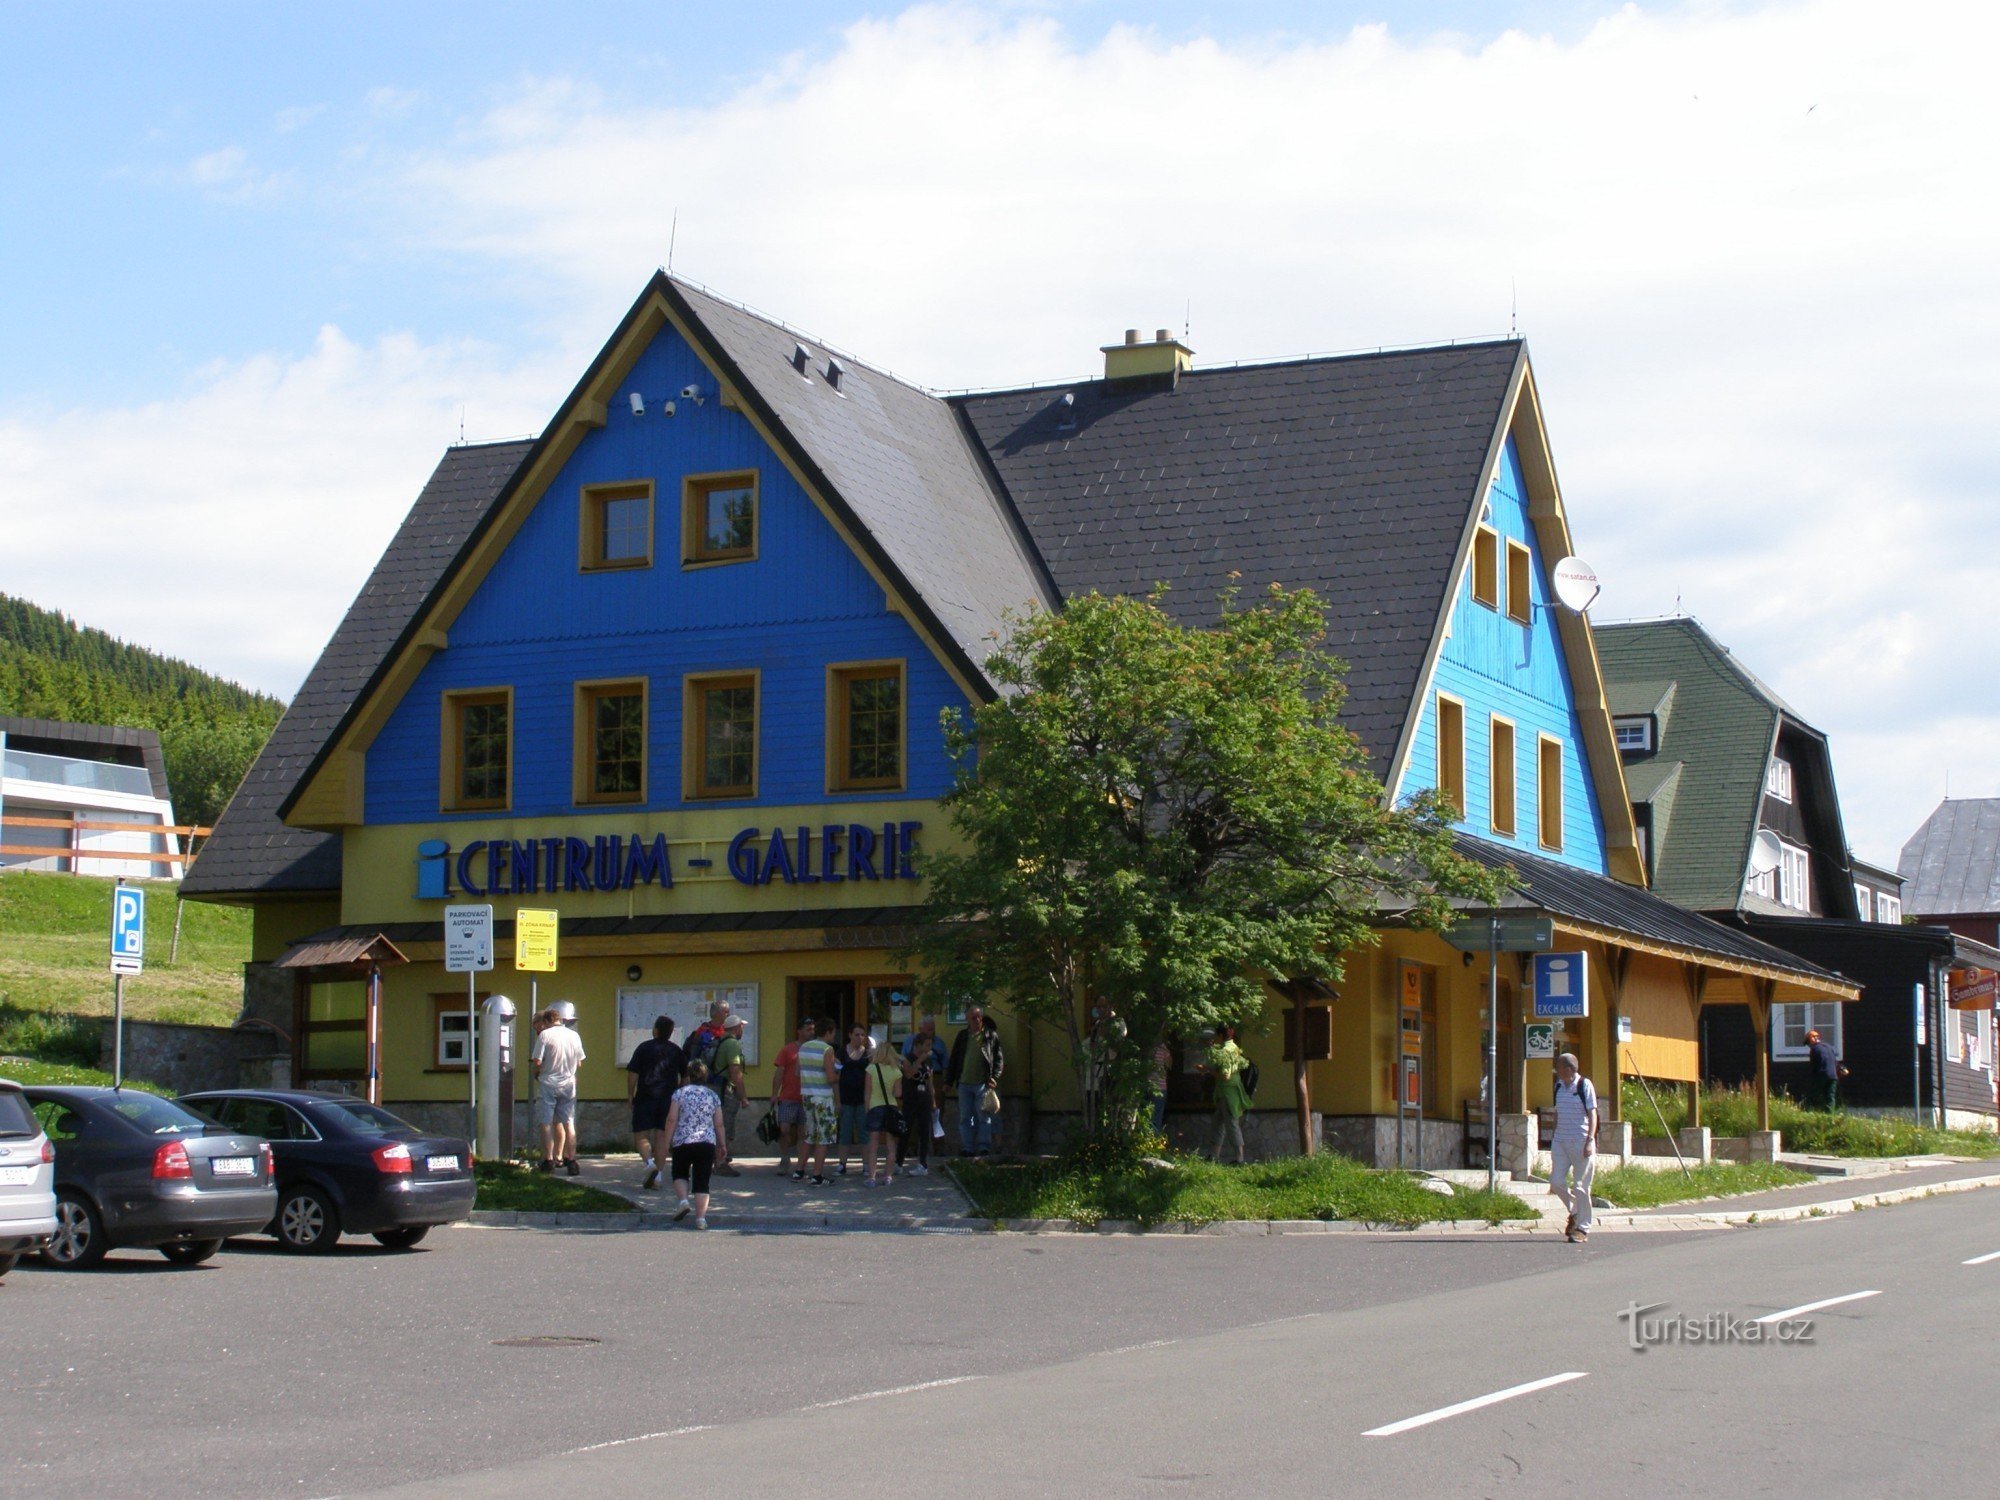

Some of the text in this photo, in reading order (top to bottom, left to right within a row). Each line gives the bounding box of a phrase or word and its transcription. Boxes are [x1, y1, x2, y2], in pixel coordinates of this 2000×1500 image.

[456, 832, 674, 897] CENTRUM
[727, 820, 923, 886] GALERIE
[119, 896, 137, 933] P
[449, 910, 487, 918] PARKOVACÍ
[1538, 1003, 1582, 1015] EXCHANGE
